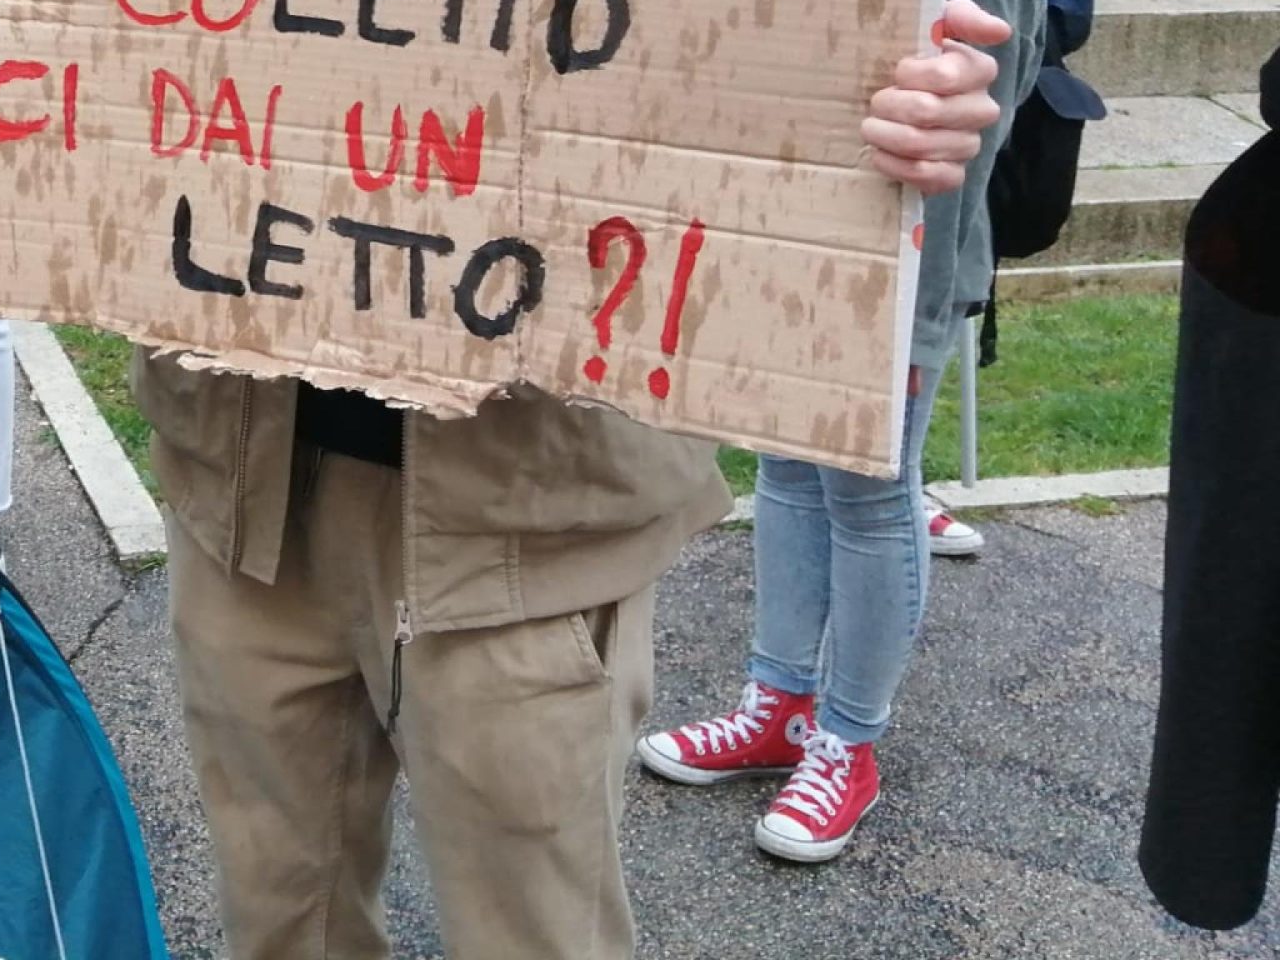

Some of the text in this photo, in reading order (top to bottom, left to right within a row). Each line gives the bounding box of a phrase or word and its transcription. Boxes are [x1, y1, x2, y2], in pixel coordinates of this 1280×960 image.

[150, 68, 283, 171] DAI
[344, 100, 485, 198] UN
[171, 194, 707, 401] LETTO ?!
